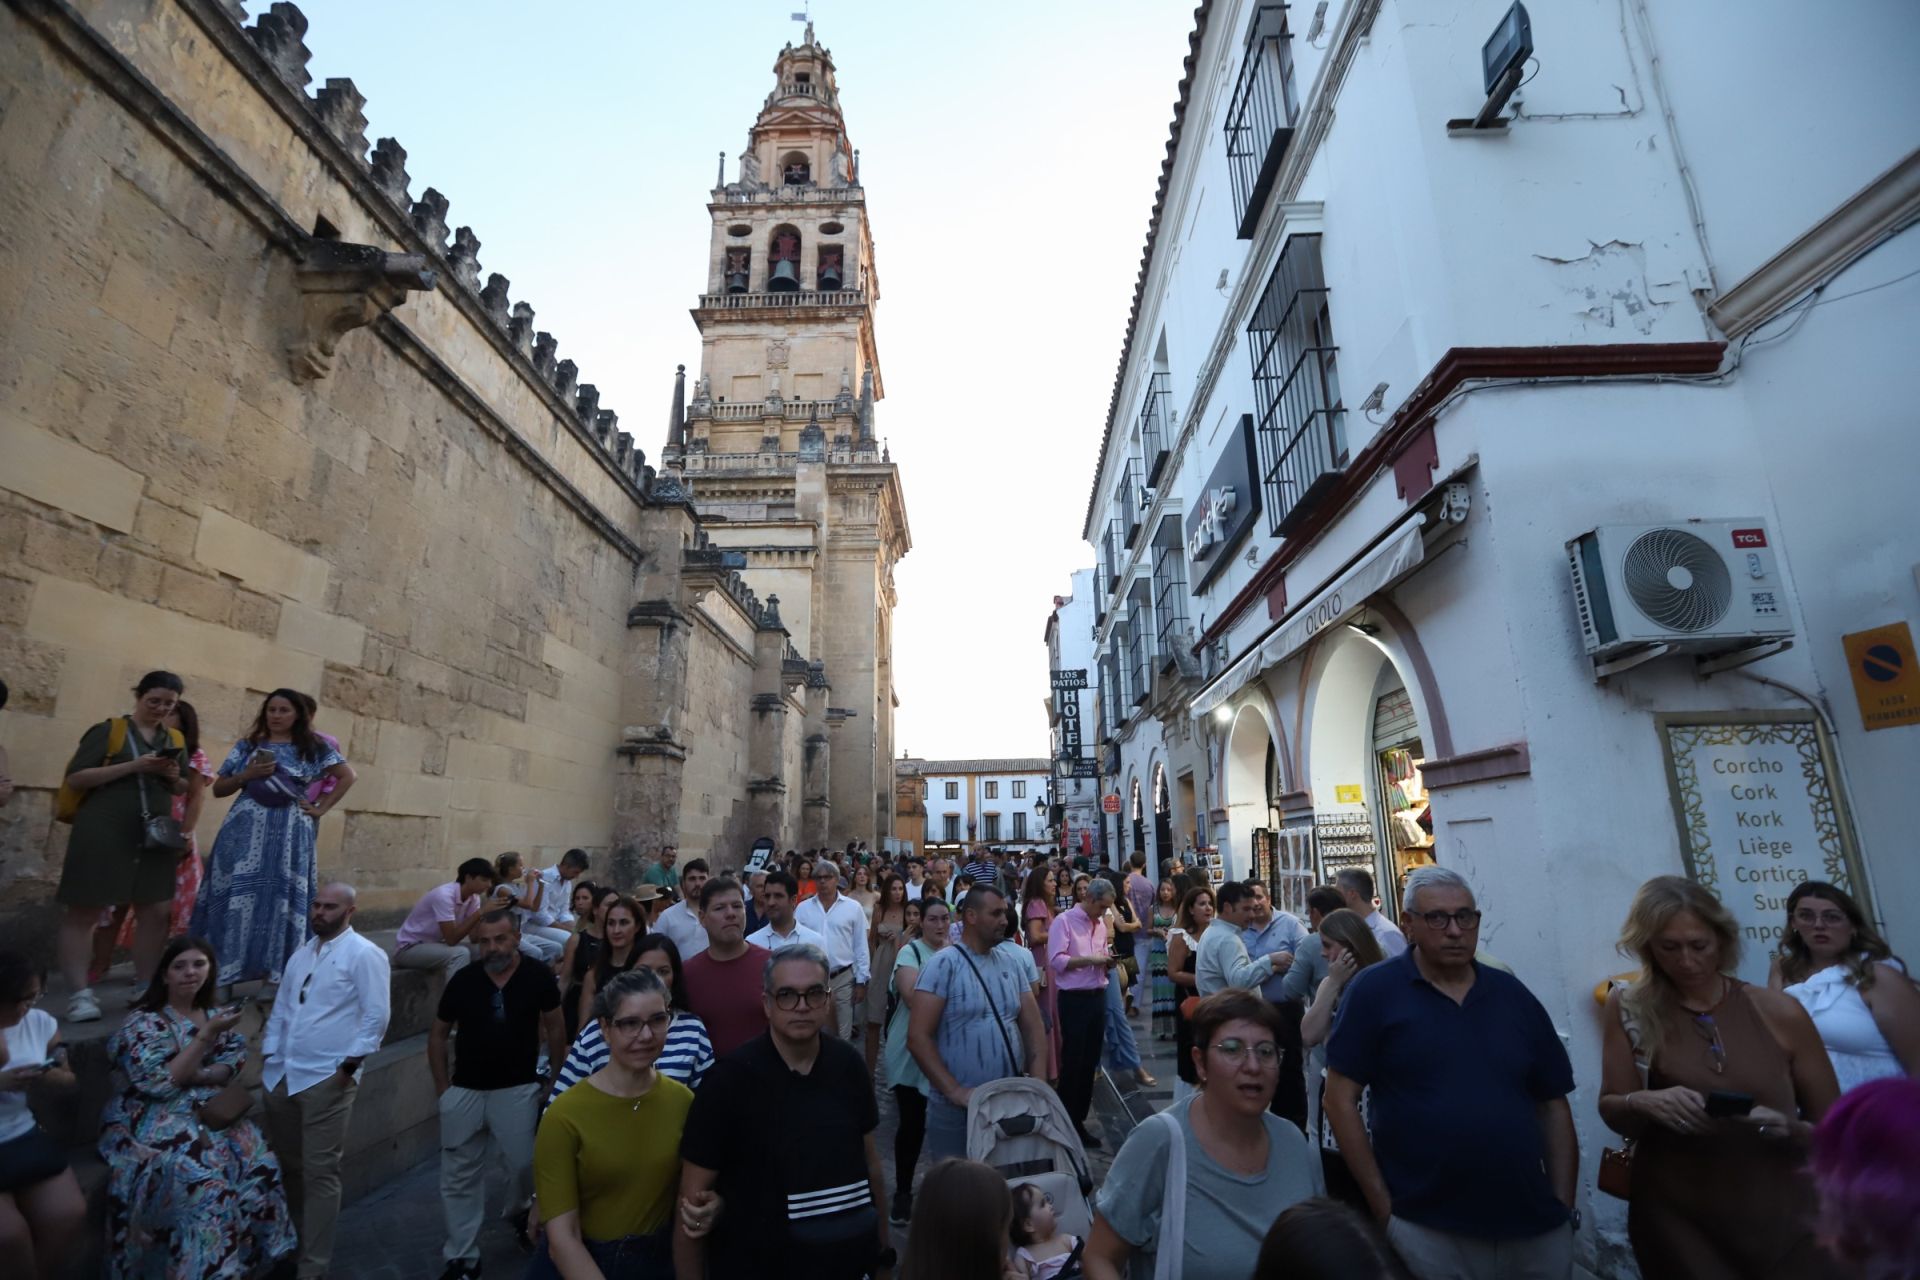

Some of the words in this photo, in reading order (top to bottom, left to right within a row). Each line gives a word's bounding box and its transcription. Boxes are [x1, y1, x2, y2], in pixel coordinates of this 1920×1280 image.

[1736, 534, 1761, 543] TCL
[1306, 593, 1342, 636] OLOLO
[1052, 679, 1086, 687] PATIOS
[1059, 671, 1078, 679] LOS
[1713, 757, 1784, 774] Corcho
[1731, 783, 1778, 801] Cork
[1736, 810, 1784, 827] Kork
[1318, 825, 1371, 835] CERAMICA
[1322, 844, 1376, 854] HANDMADE
[1739, 836, 1792, 859] Liège
[1735, 865, 1809, 887] Cortiça
[1745, 926, 1784, 944] про
